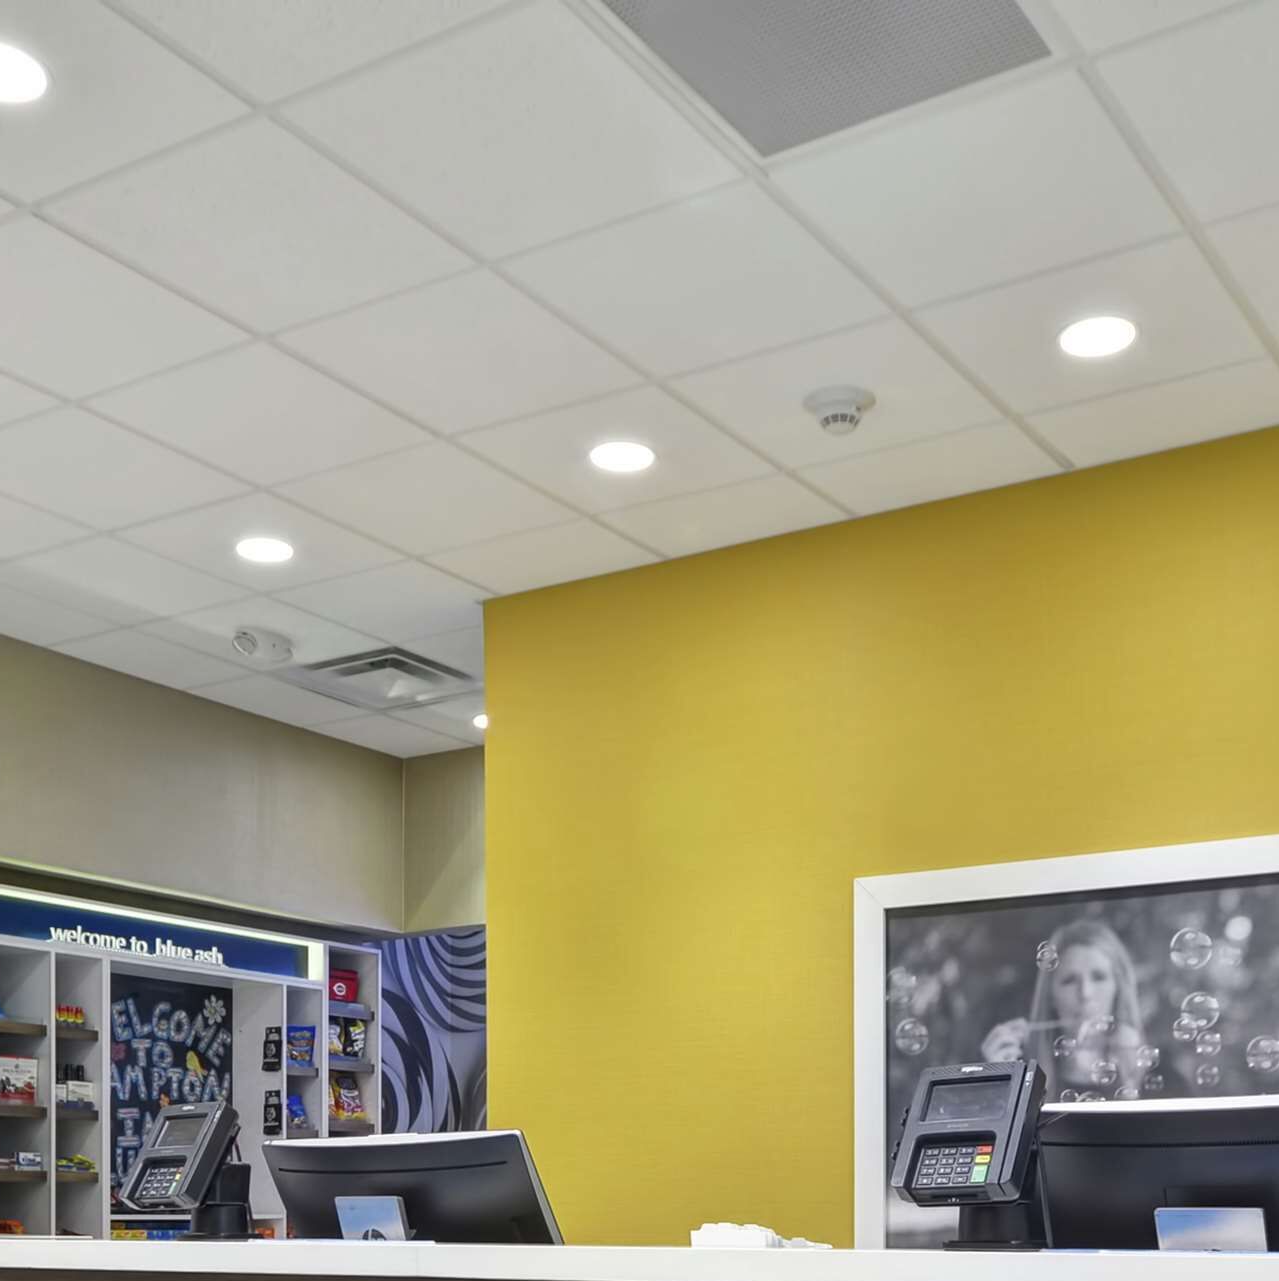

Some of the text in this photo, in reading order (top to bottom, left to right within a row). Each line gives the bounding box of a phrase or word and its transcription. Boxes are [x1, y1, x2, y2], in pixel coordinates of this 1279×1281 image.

[49, 925, 224, 965] welcome to blue ash
[111, 997, 232, 1067] ELCOME
[111, 1063, 232, 1103] AMPTON
